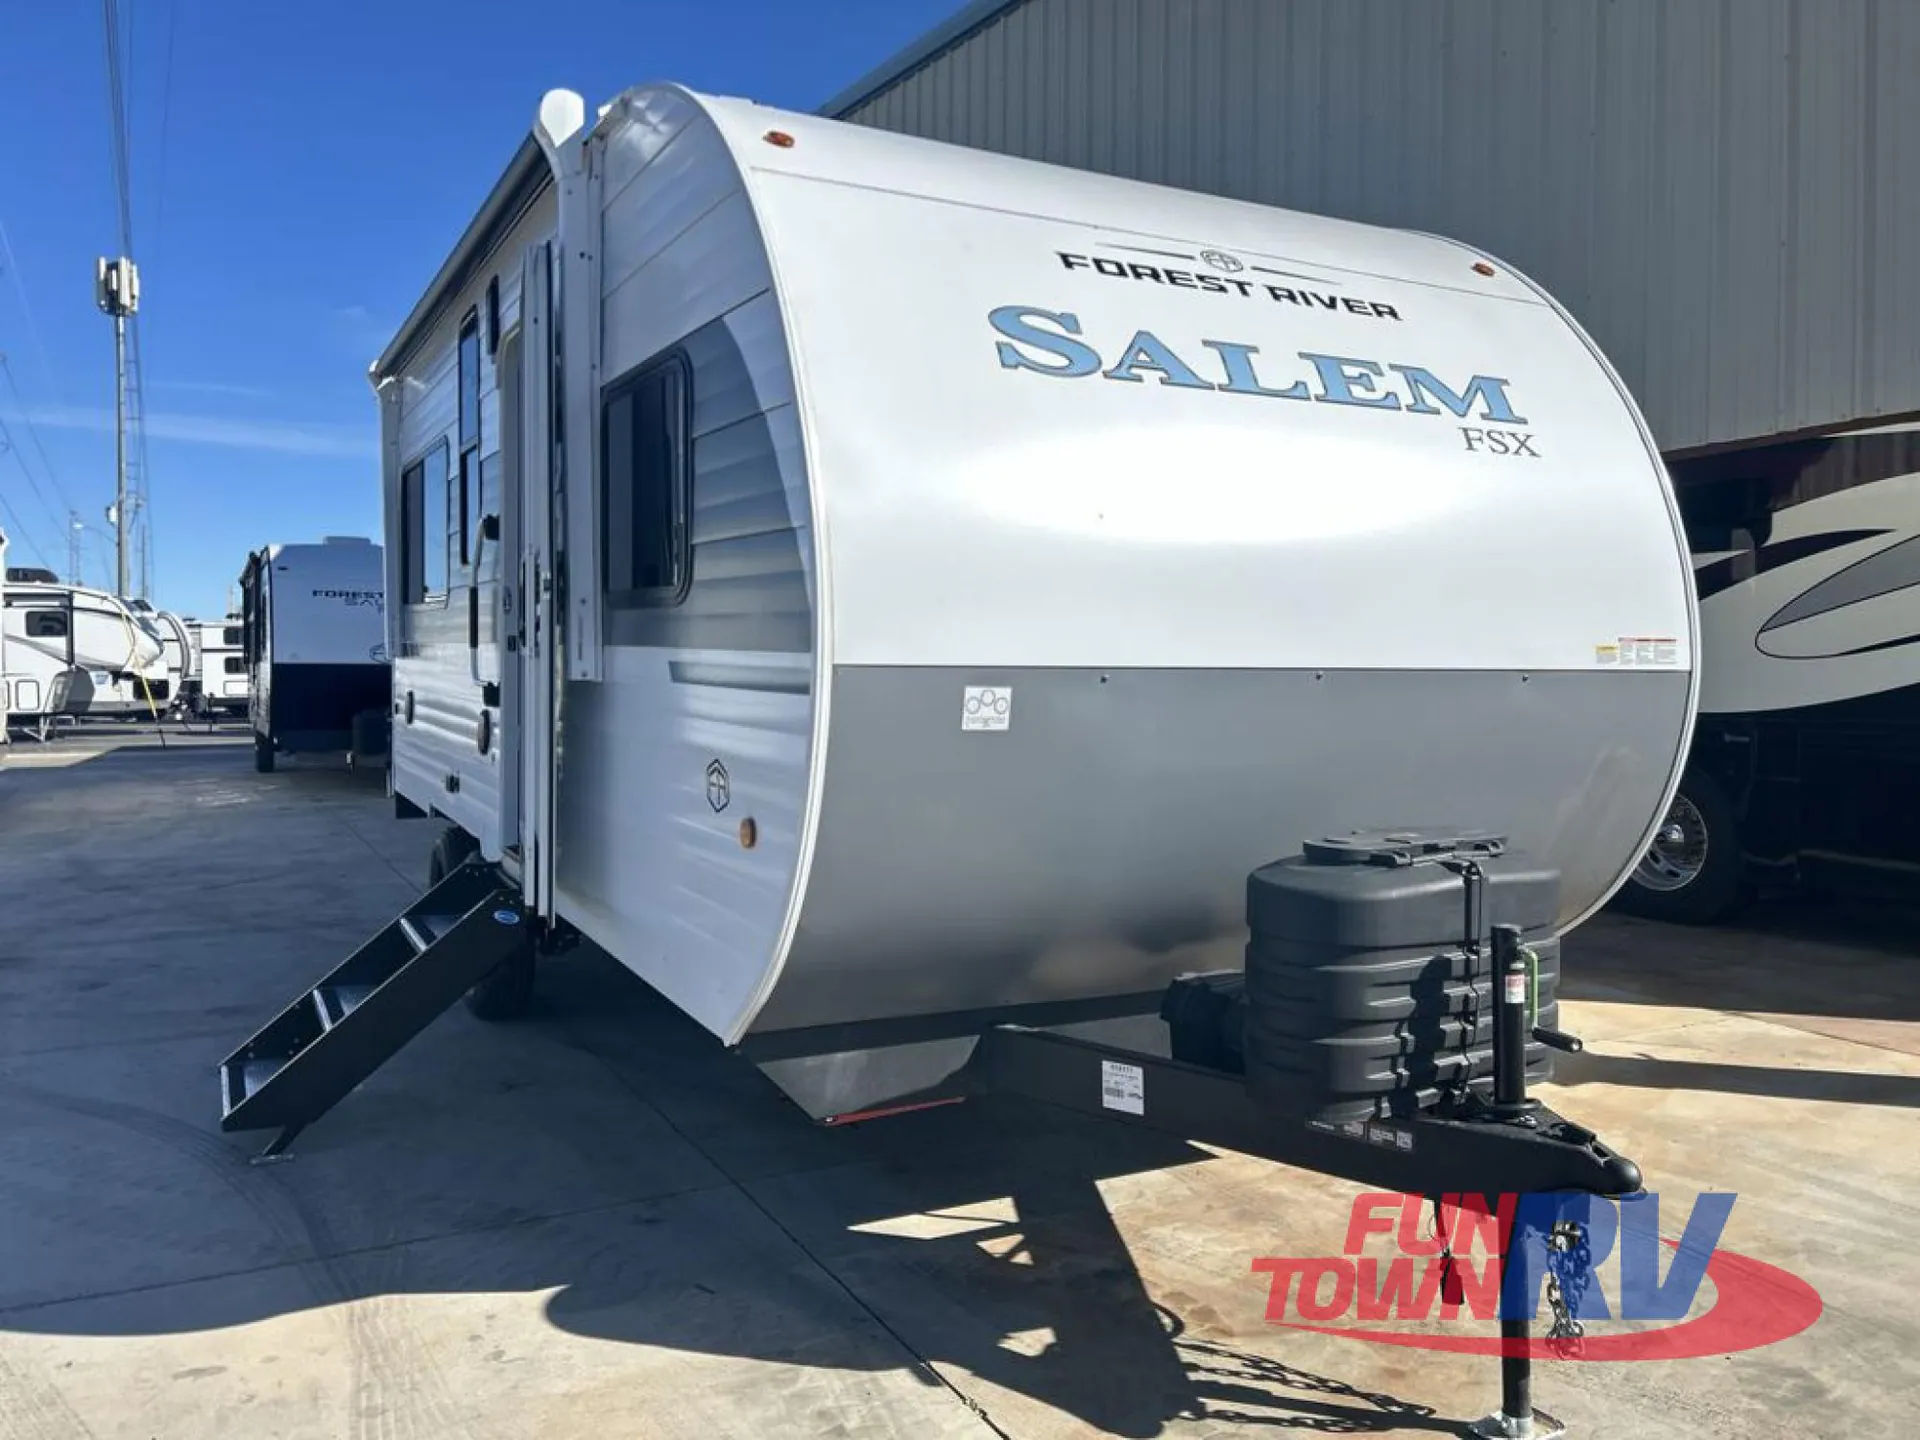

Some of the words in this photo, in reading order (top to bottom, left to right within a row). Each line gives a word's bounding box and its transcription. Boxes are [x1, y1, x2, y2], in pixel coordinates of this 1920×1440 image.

[1056, 251, 1253, 297] FOREST
[1263, 284, 1402, 321] RIVER
[988, 305, 1528, 425] SALEM
[1458, 426, 1542, 458] FSX
